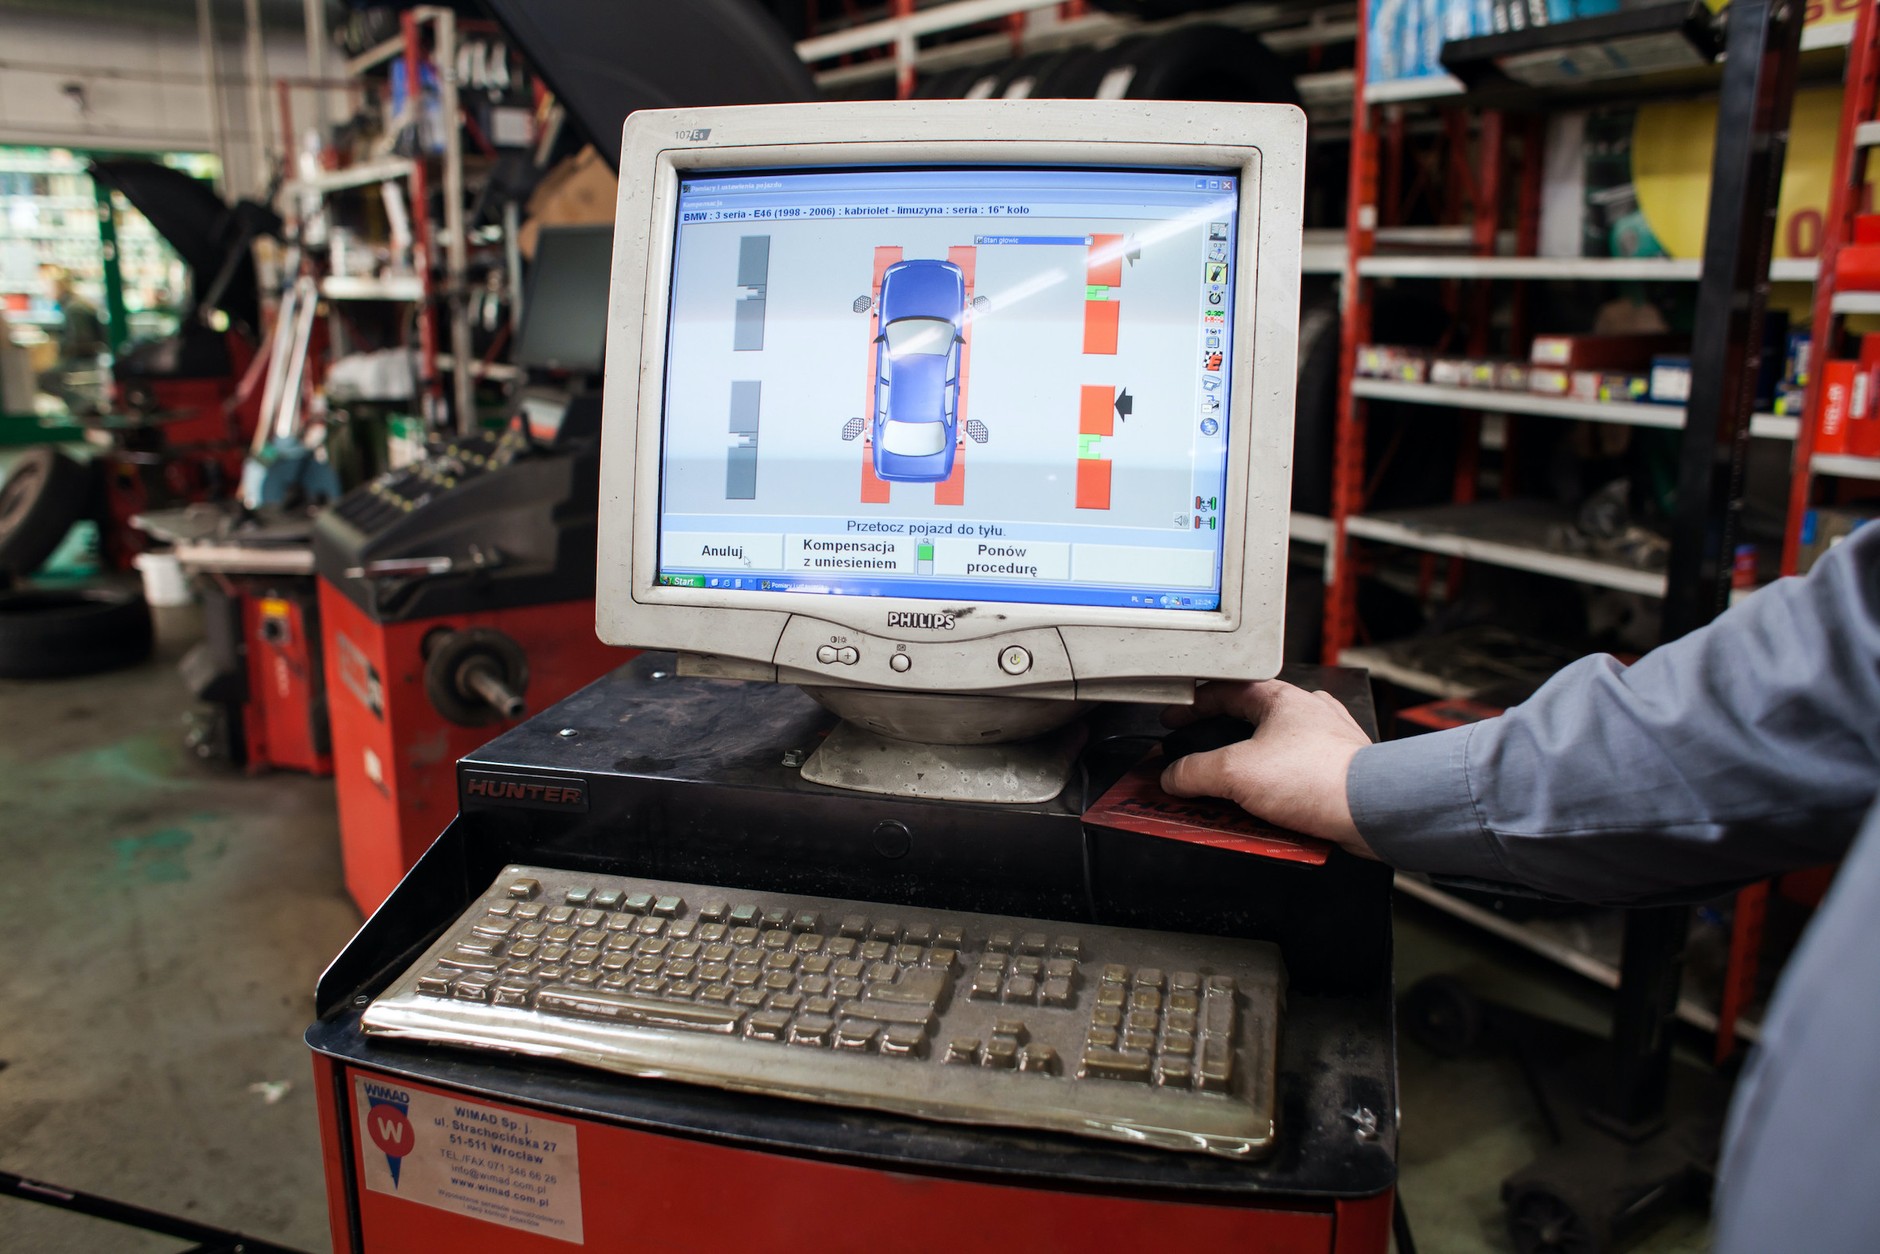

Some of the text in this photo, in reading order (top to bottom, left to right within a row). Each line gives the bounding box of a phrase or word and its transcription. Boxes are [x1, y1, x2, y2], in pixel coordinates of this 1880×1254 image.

[756, 181, 783, 190] pojazdu
[683, 211, 708, 222] BMW
[715, 211, 721, 219] 3
[723, 209, 746, 219] seria
[753, 208, 772, 218] E46
[774, 207, 801, 219] (1998
[809, 206, 836, 217] 2006)
[844, 205, 889, 216] kabriolet
[897, 205, 943, 217] limuzyna
[952, 205, 978, 215] seria
[983, 236, 998, 244] Stan
[847, 520, 1007, 538] Przetocz pojazd do tyłu.
[701, 544, 743, 560] Anuluj
[803, 538, 895, 555] Kompensacja
[977, 543, 1027, 557] Ponów
[804, 556, 897, 569] z uniesieniem
[966, 562, 1038, 577] procedurę
[674, 576, 694, 587] Start
[887, 611, 956, 630] PHILIPS
[467, 778, 582, 804] HUNTER
[364, 1082, 410, 1104] WIMAD
[454, 1106, 497, 1125] WIMAD
[501, 1116, 522, 1131] Sp.
[377, 1116, 403, 1143] W
[434, 1117, 557, 1153] ul. Strachocińska 27
[449, 1133, 487, 1152] 51-511
[451, 1164, 547, 1195] info@wimad.com.pl
[450, 1177, 549, 1208] www.wimad.com.pl
